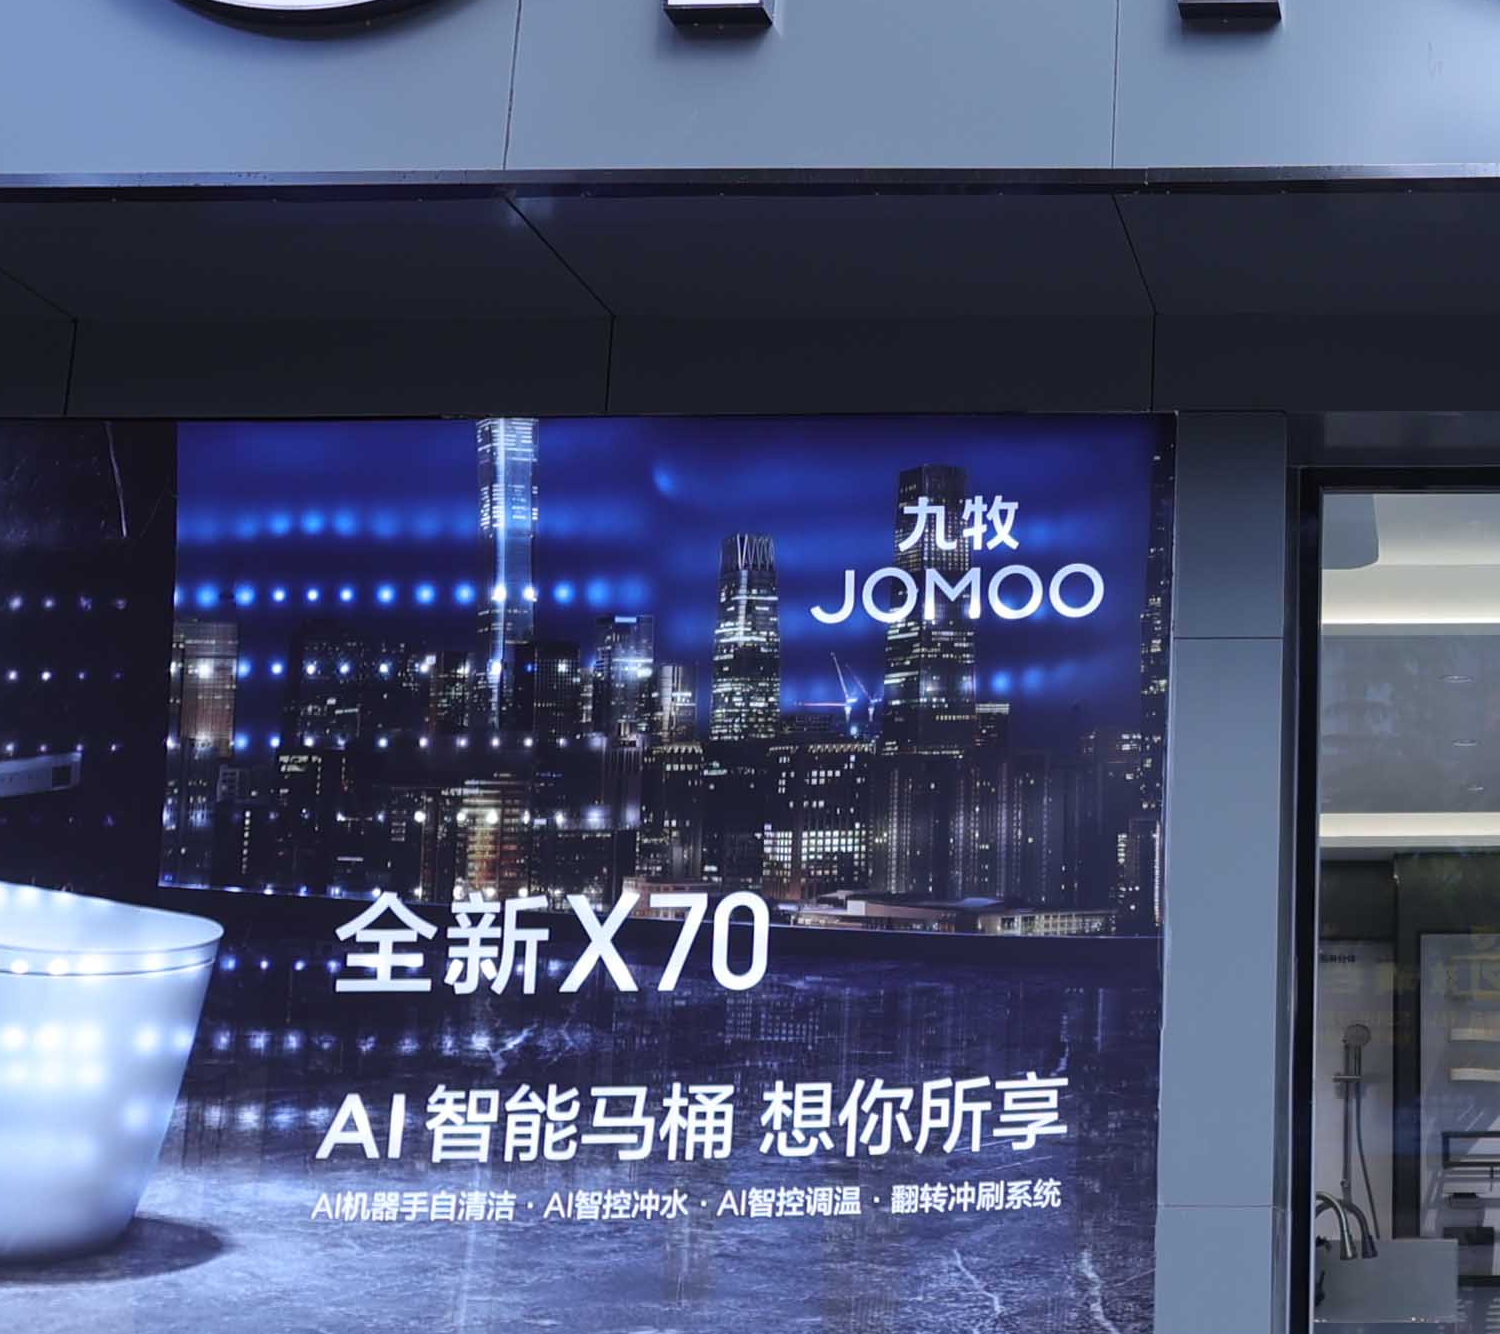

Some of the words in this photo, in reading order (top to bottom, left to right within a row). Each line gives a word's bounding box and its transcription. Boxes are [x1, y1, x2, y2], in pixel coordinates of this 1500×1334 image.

[898, 495, 1021, 551] 九牧
[810, 562, 1105, 624] JOMOO
[334, 890, 772, 996] 全新X70
[314, 1092, 404, 1159] AI
[425, 1082, 735, 1162] 智能马桶
[759, 1070, 1070, 1158] 想你所享
[310, 1189, 517, 1222] AI机器手自清洁
[542, 1188, 691, 1220] AI智控冲水
[715, 1185, 863, 1219] AI智控调温
[889, 1177, 1064, 1215] 翻转冲刷系统
